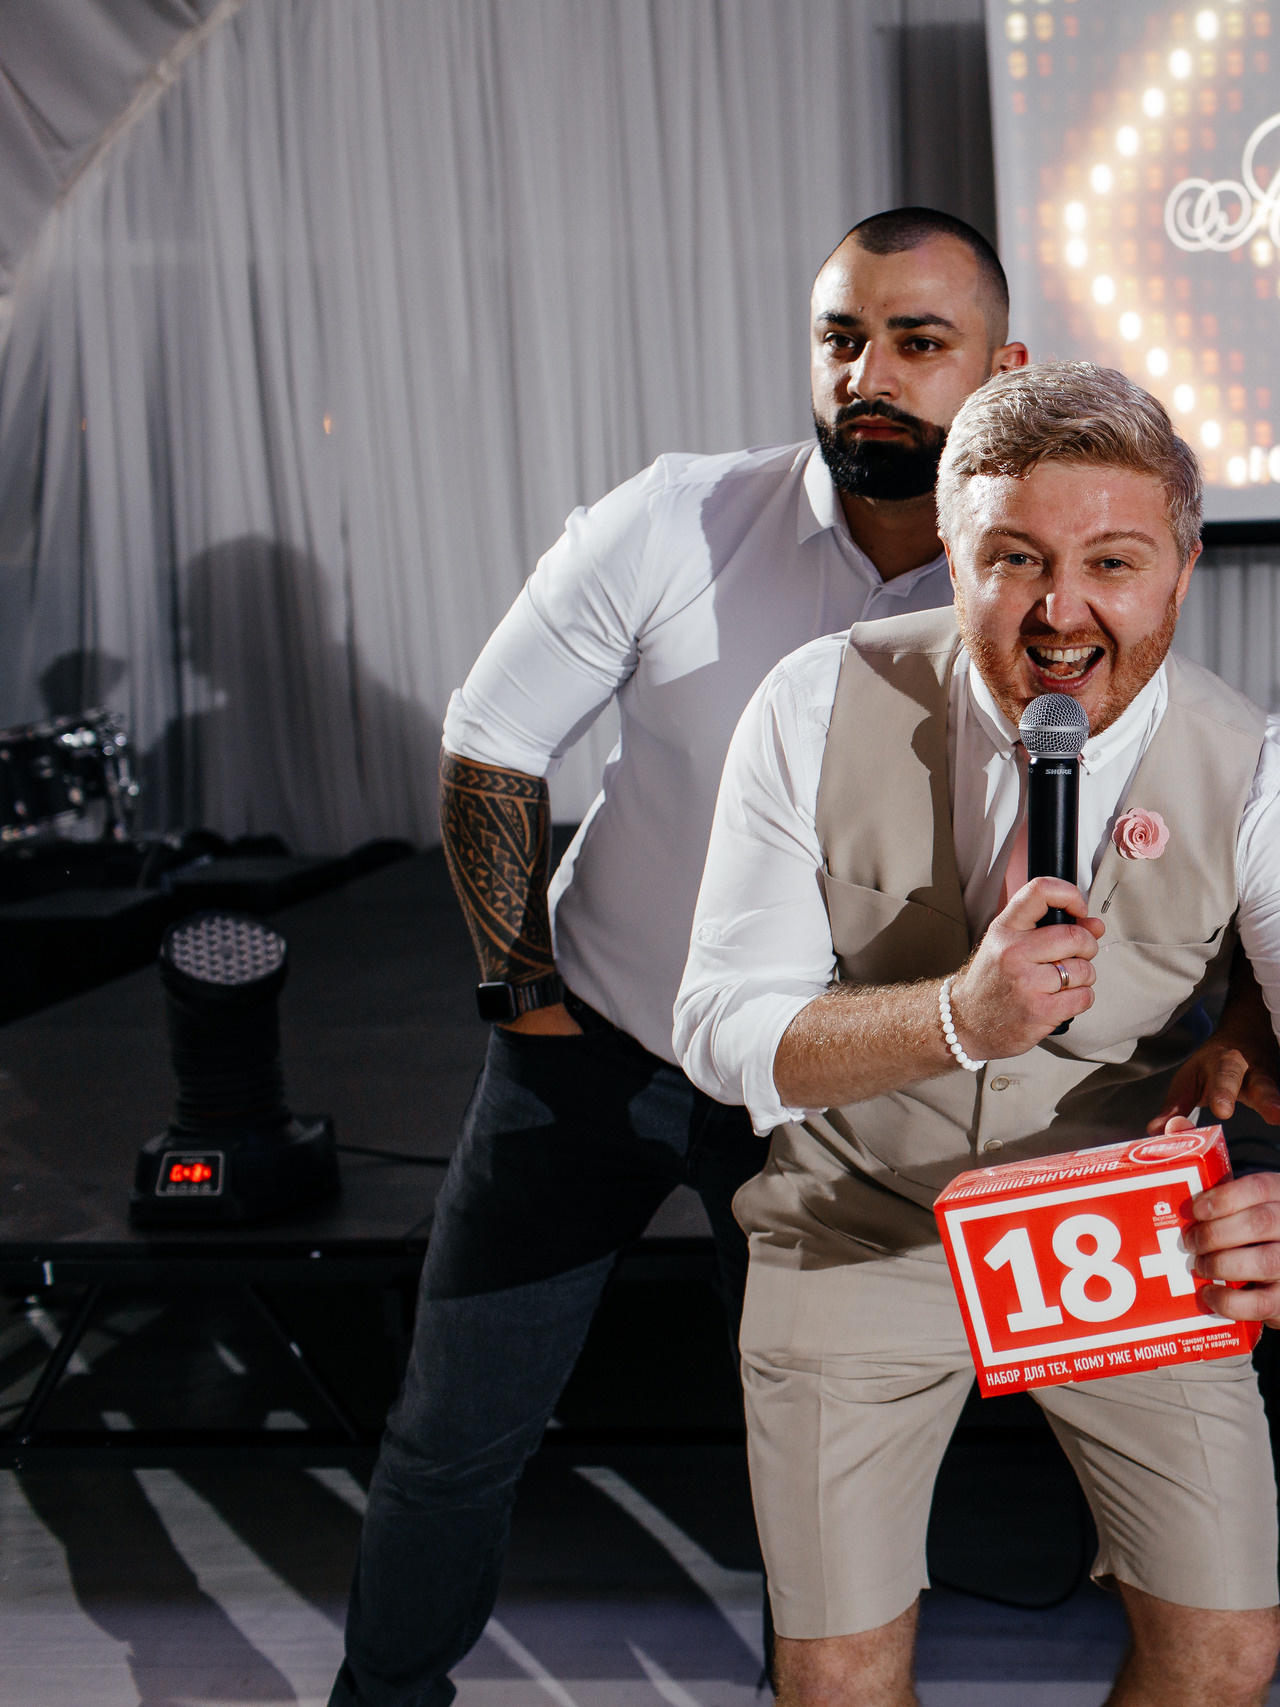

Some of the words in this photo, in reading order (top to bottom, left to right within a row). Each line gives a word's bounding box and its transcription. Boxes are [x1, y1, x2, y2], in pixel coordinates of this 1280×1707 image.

[983, 1213, 1198, 1333] 18+
[1192, 1344, 1203, 1352] еду
[1210, 1337, 1240, 1349] квартиру
[1206, 1332, 1232, 1342] платить
[986, 1369, 1021, 1387] НАБОР
[1024, 1364, 1046, 1382] ДЛЯ
[1047, 1360, 1072, 1376] ТЕХ,
[1074, 1354, 1104, 1372] КОМУ
[1108, 1349, 1133, 1366] УЖЕ
[1134, 1342, 1177, 1362] МОЖНО
